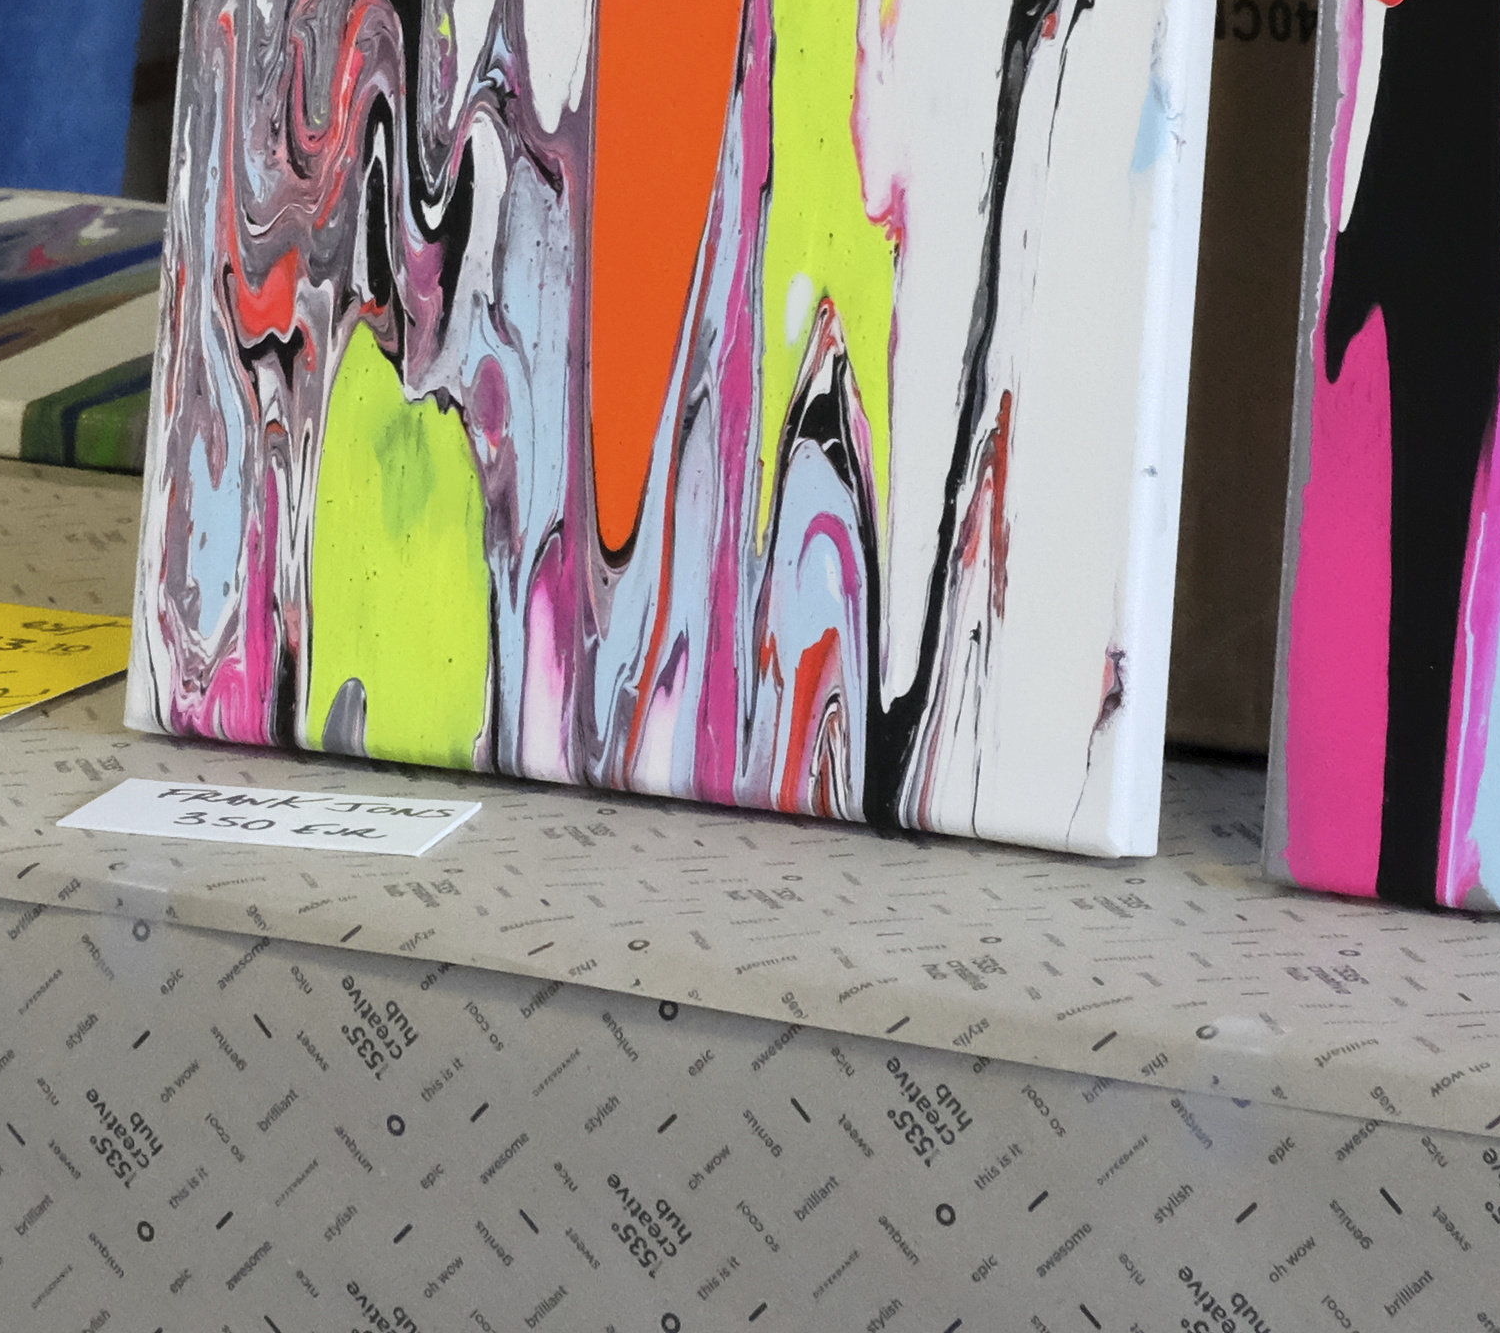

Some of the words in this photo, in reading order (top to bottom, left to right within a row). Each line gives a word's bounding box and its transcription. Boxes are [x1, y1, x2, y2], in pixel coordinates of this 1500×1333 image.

[157, 788, 334, 809] FRANK
[325, 802, 456, 819] JONS
[173, 811, 277, 832] 350
[290, 823, 388, 839] EUR
[159, 968, 184, 996] epic
[65, 1013, 99, 1050] stylish
[341, 975, 403, 1060] creative
[386, 1000, 418, 1047] hub
[210, 1025, 248, 1072] genius
[341, 1025, 389, 1081] 1535°
[36, 1077, 60, 1107] nice
[583, 1095, 621, 1134] stylish
[886, 1056, 955, 1146] creative
[935, 1083, 973, 1132] hub
[86, 1088, 150, 1169] creative
[130, 1113, 163, 1156] hub
[333, 1125, 374, 1174] unique
[837, 1112, 875, 1159] sweet
[887, 1109, 938, 1168] 1535°
[48, 1139, 82, 1180] sweet
[89, 1135, 136, 1189] 1535°
[479, 1132, 530, 1185] awesome
[607, 1173, 677, 1258] creative
[656, 1198, 692, 1245] hub
[793, 1175, 840, 1222] brilliant
[1153, 1183, 1194, 1224] stylish
[474, 1220, 515, 1268] genius
[1328, 1198, 1374, 1251] genius
[1431, 1205, 1472, 1252] sweet
[611, 1222, 661, 1279] 1535°
[970, 1255, 999, 1283] epic
[1035, 1222, 1093, 1279] awesome
[1118, 1252, 1146, 1287] nice
[523, 1284, 569, 1329] brilliant
[1383, 1269, 1435, 1319] brilliant
